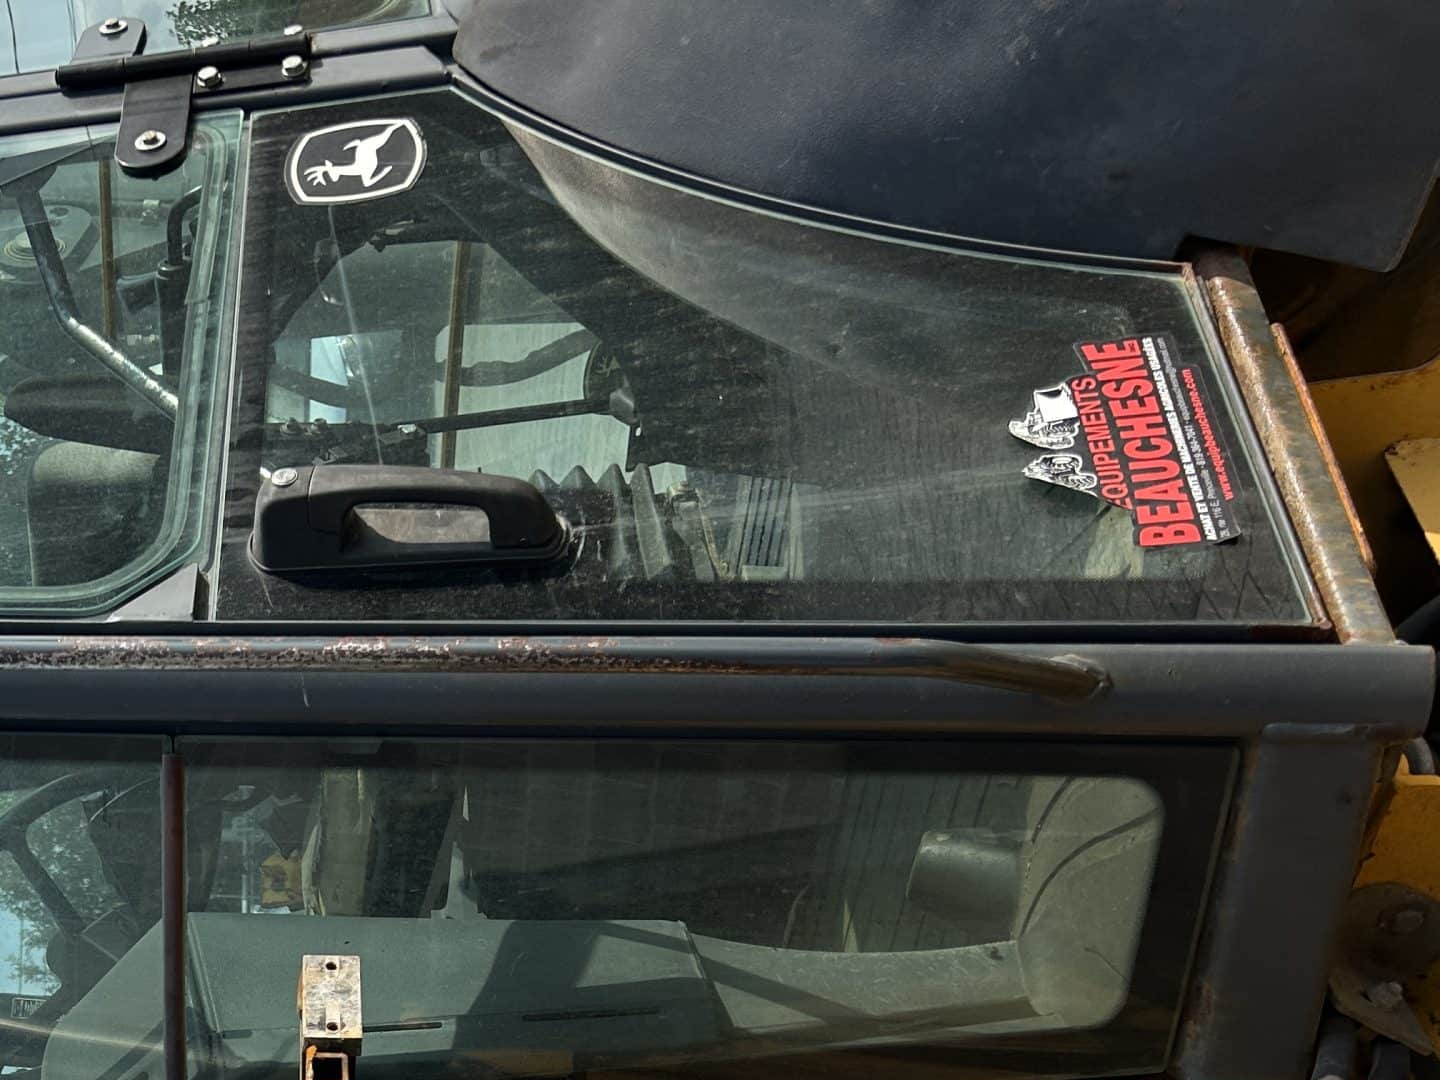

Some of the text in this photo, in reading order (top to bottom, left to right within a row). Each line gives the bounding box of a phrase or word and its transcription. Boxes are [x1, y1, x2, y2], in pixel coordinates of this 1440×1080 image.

[1153, 370, 1175, 411] AGRICOLES
[1081, 339, 1201, 546] BEAUCHESNE
[1167, 410, 1194, 463] MACHINERIES
[1181, 368, 1234, 501] www.equipbeauchesne.com
[1185, 463, 1197, 474] DE
[1189, 475, 1204, 502] VENTE
[1196, 502, 1209, 513] ET
[1199, 514, 1218, 540] ACHAT
